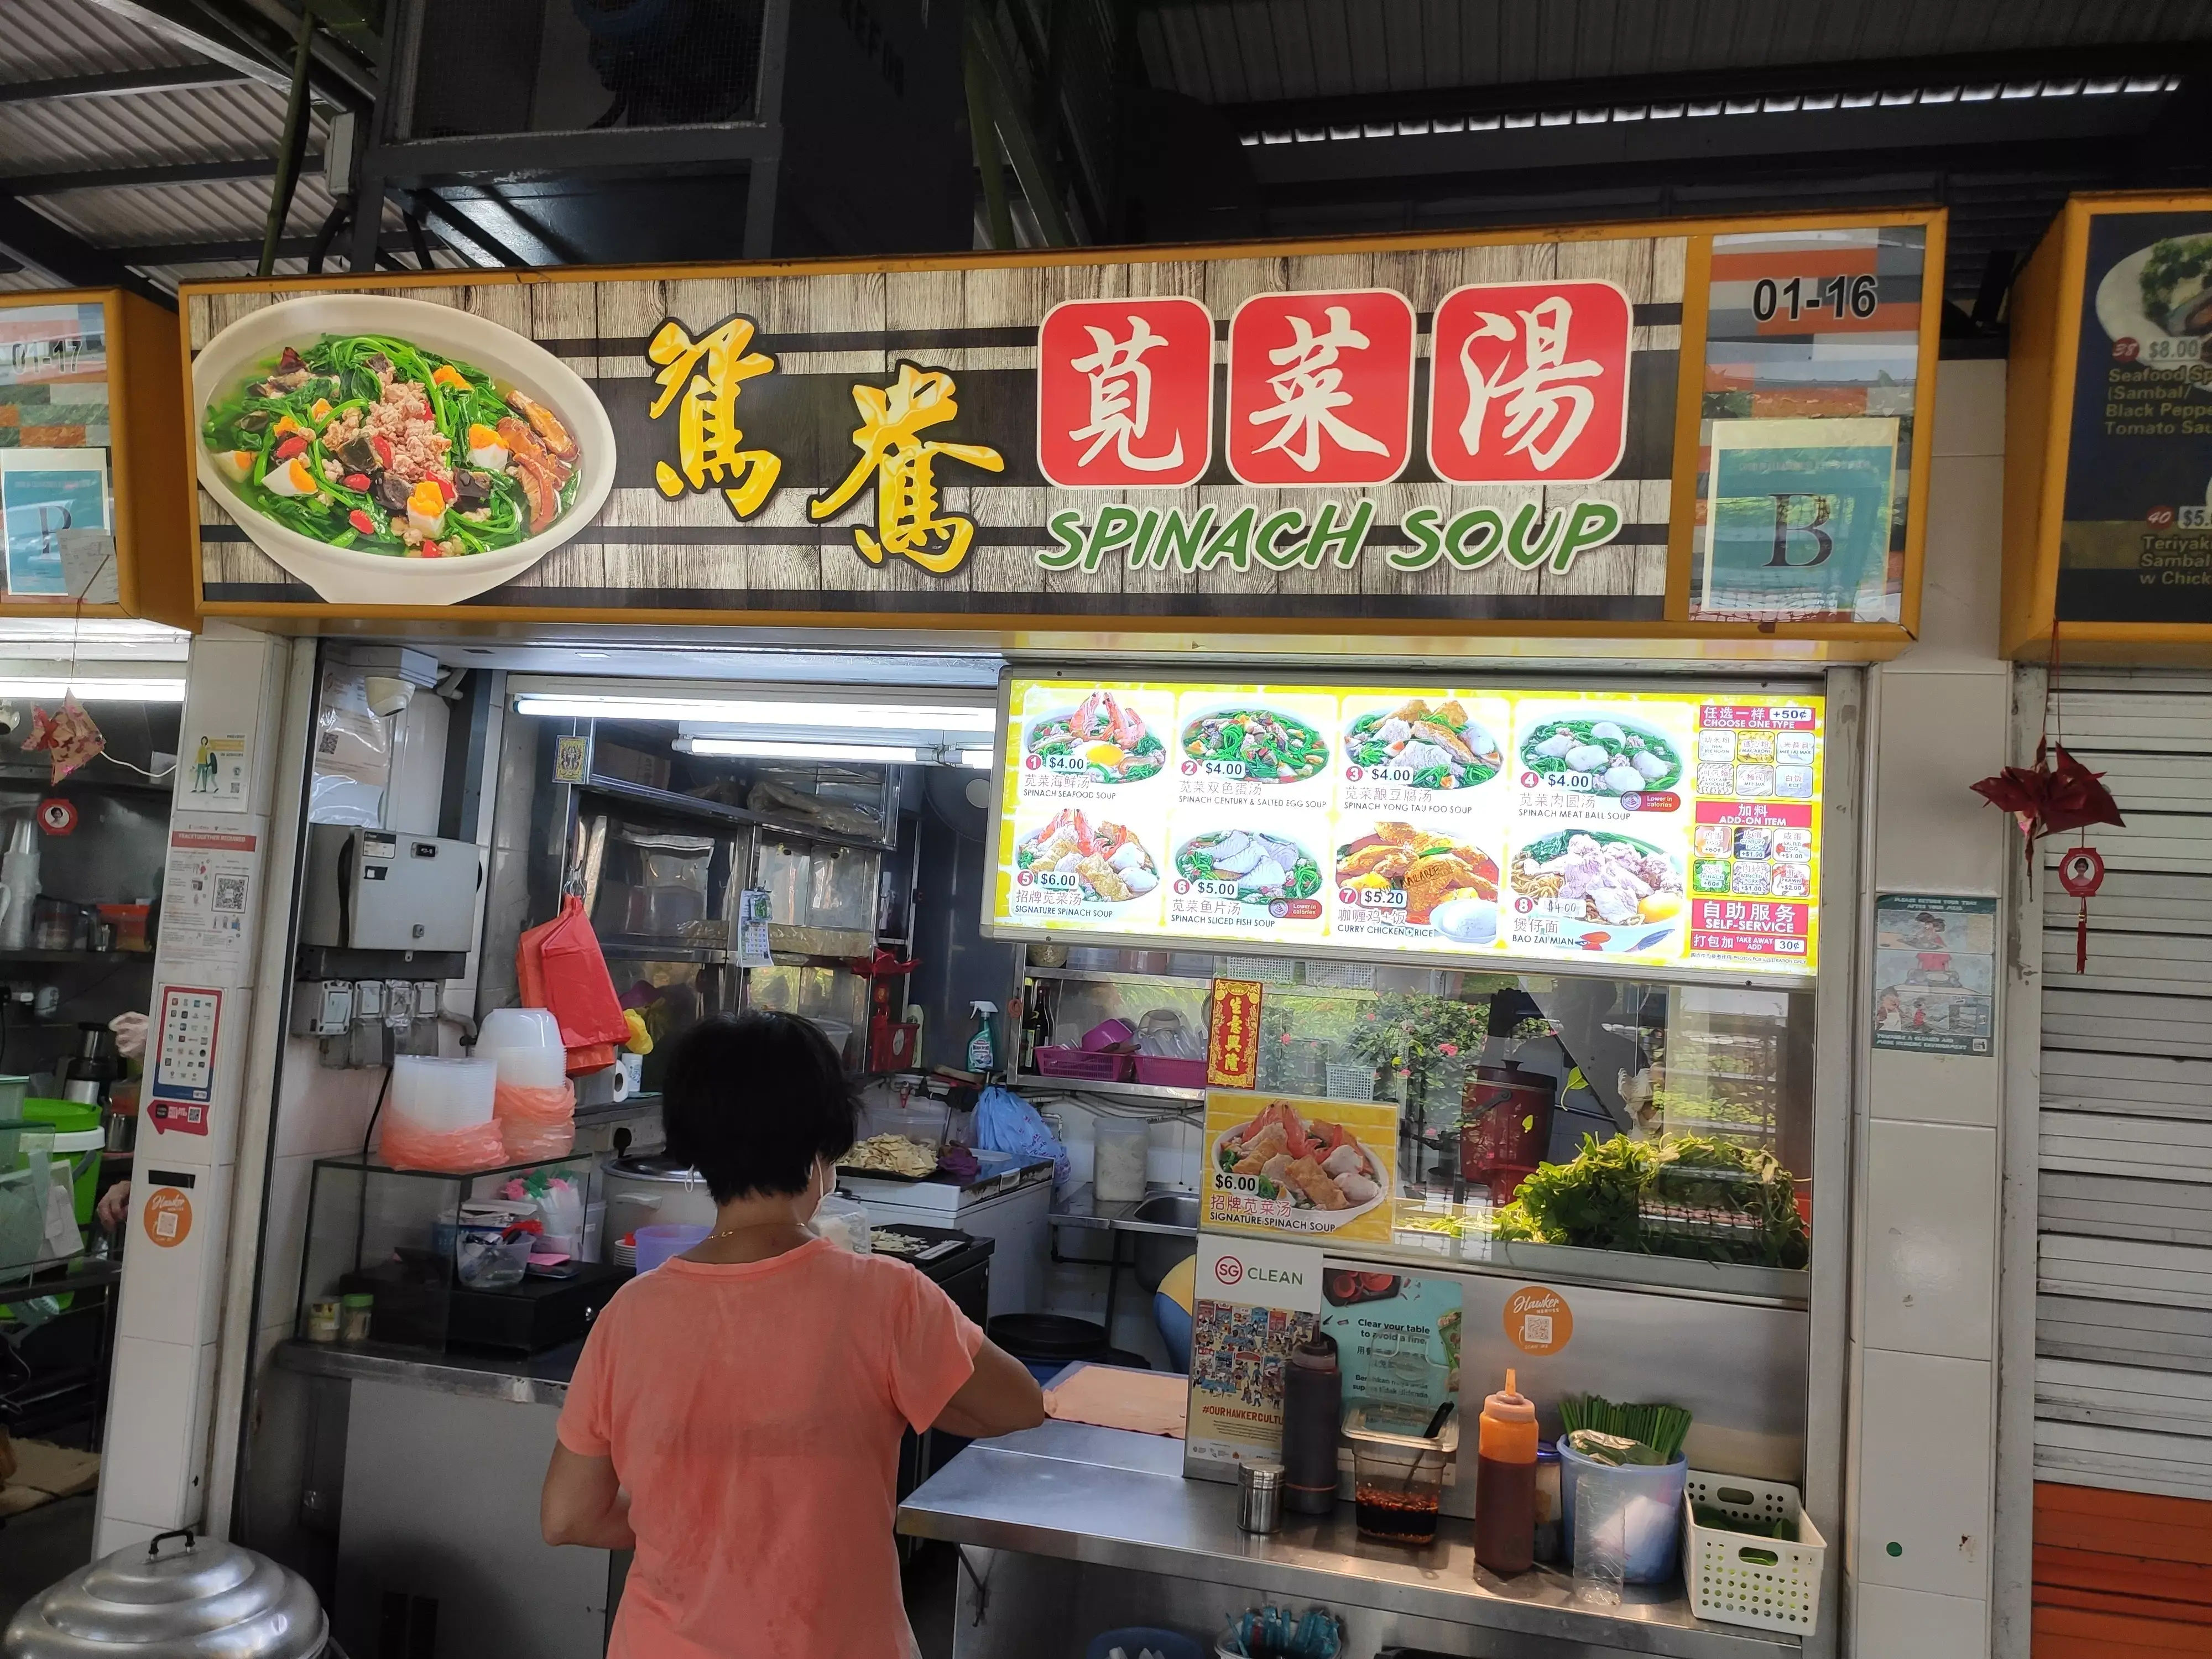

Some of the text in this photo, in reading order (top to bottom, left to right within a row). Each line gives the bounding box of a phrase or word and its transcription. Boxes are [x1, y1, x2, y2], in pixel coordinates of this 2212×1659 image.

[1752, 275, 1877, 322] 01-16
[2112, 343, 2137, 357] 38
[2149, 340, 2198, 358] $8.00
[12, 339, 82, 375] 01-17
[2108, 365, 2187, 383] Seafood
[2107, 384, 2193, 401] (Sambal/
[2106, 403, 2154, 418] Black
[2105, 421, 2176, 435] Tomato
[2147, 511, 2172, 524] 40
[2183, 509, 2212, 527] $5.
[1762, 493, 1833, 567] B
[1037, 502, 1619, 573] SPINACH SOUP
[2139, 573, 2156, 585] w
[1703, 706, 1765, 721] 任选一样
[1773, 709, 1807, 719] +50¢
[1703, 719, 1746, 728] CHOOSE
[1748, 720, 1770, 728] ONE
[1049, 757, 1084, 769] $4.00
[1206, 762, 1243, 775] $4.00
[1371, 768, 1411, 781] $4.00
[1548, 774, 1589, 787] $4.00
[1024, 789, 1056, 797] SPINACH
[1058, 790, 1094, 799] SEAFOOD
[1179, 795, 1212, 804] SPINACH
[1344, 802, 1380, 810] SPINACH
[1383, 804, 1408, 812] YONG
[1429, 805, 1448, 813] FOO
[1450, 806, 1473, 814] SOUP
[1519, 808, 1631, 821] SPINACH MEAT BALL SOUP
[1738, 804, 1768, 817] 加料
[1719, 816, 1787, 826] ADD-ON ITEM
[1041, 873, 1076, 886] $6.00
[1197, 881, 1235, 895] $5.00
[1016, 889, 1082, 906] 招牌苋菜汤
[1364, 890, 1404, 904] $5.20
[1015, 905, 1113, 918] SIGNATURE SPINACH SOUP
[1703, 900, 1796, 923] 自助服务
[1171, 914, 1275, 927] SPINACH SLICED FISH SOUP
[1514, 917, 1559, 933] 煲仔面
[1705, 918, 1794, 933] SELF-SERVICE
[1338, 924, 1433, 937] CURRY CHICKEN RICE
[1512, 935, 1574, 946] BAO ZAI MIAN
[1693, 933, 1734, 949] 打包加
[1736, 936, 1752, 944] TAKE
[1779, 941, 1799, 950] 30¢
[1215, 1173, 1256, 1192] $6.00
[1209, 1194, 1292, 1218] 招牌苋菜汤
[1209, 1211, 1336, 1233] SIGNATURE SPINACH SOUP
[1219, 1264, 1303, 1285] SG CLEAN
[1513, 1293, 1559, 1314] Hawker
[1358, 1318, 1431, 1334] Clear your table
[1360, 1329, 1370, 1338] to
